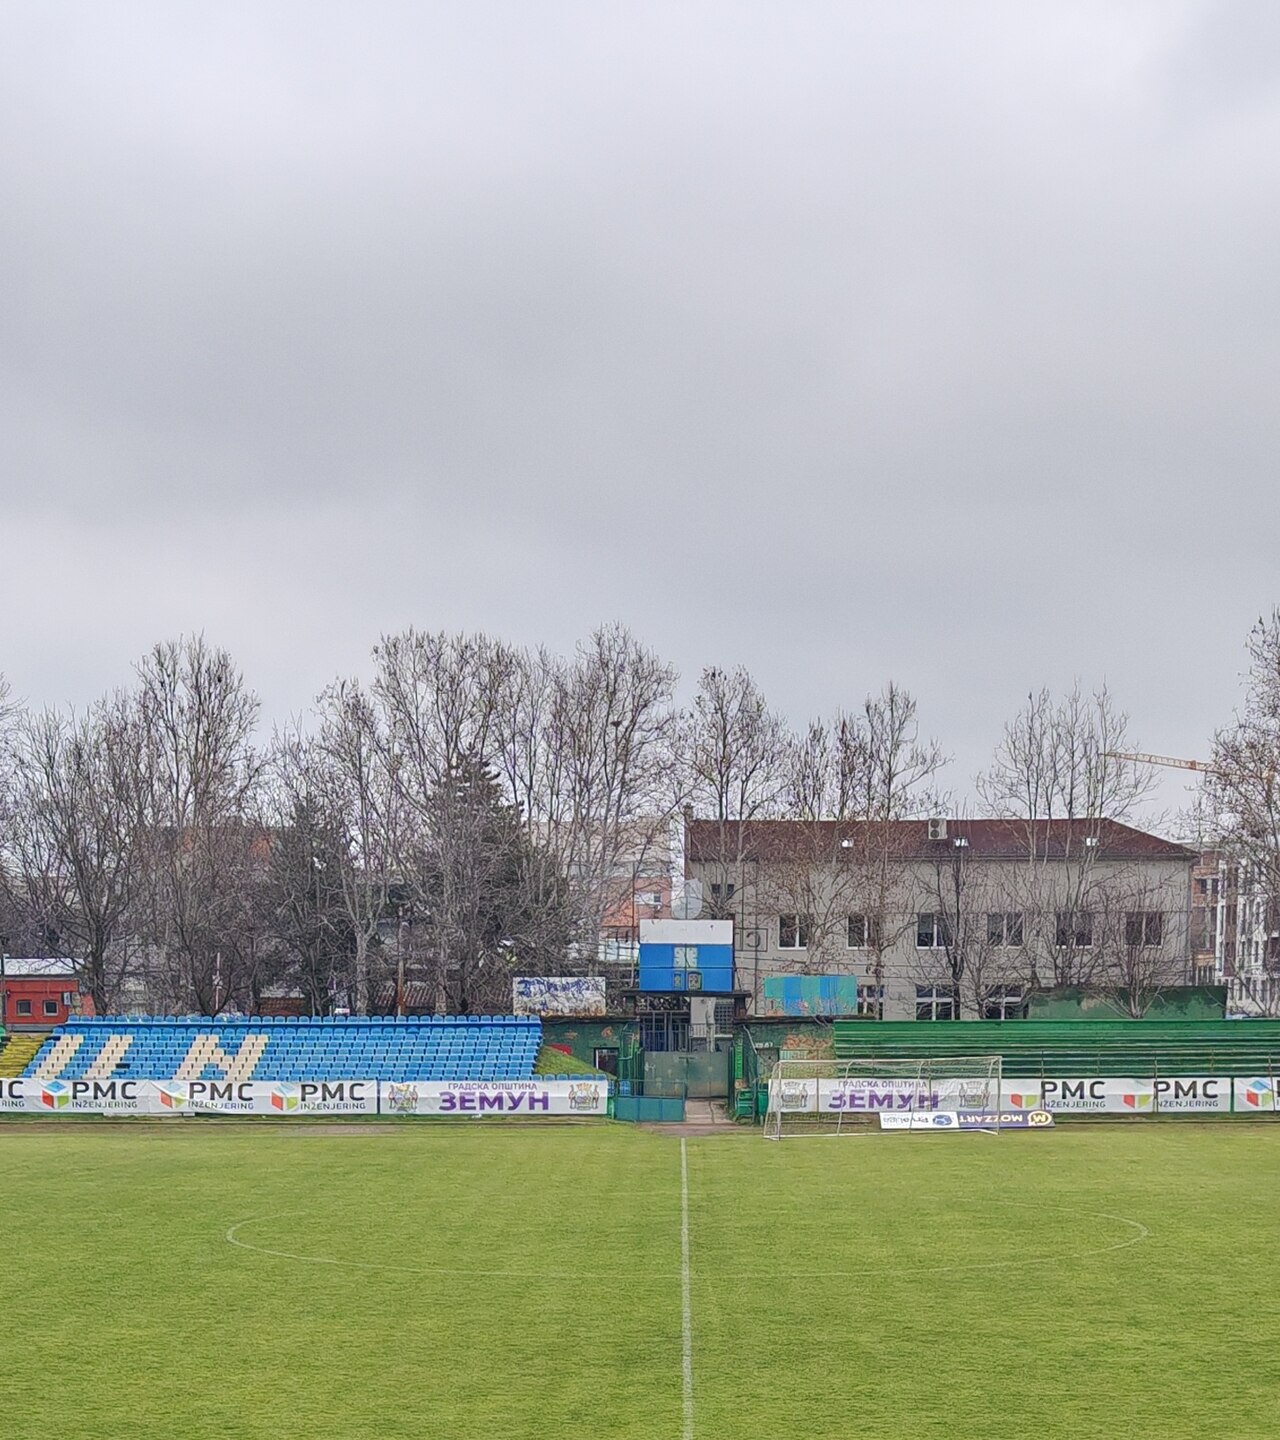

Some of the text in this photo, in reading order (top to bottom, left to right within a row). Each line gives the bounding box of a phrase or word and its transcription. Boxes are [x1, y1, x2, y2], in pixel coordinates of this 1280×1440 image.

[72, 1081, 137, 1100] PMC
[189, 1082, 254, 1101] PMC
[301, 1082, 366, 1101] PMC
[448, 1083, 489, 1091] ГРАДСКА
[1041, 1081, 1106, 1100] PMC
[1154, 1080, 1218, 1099] PMC
[72, 1100, 138, 1109] INŽENJERING
[300, 1101, 366, 1110] INŽENJERING
[439, 1092, 549, 1111] ЗЕМУН
[829, 1090, 939, 1109] ЗЕМУН
